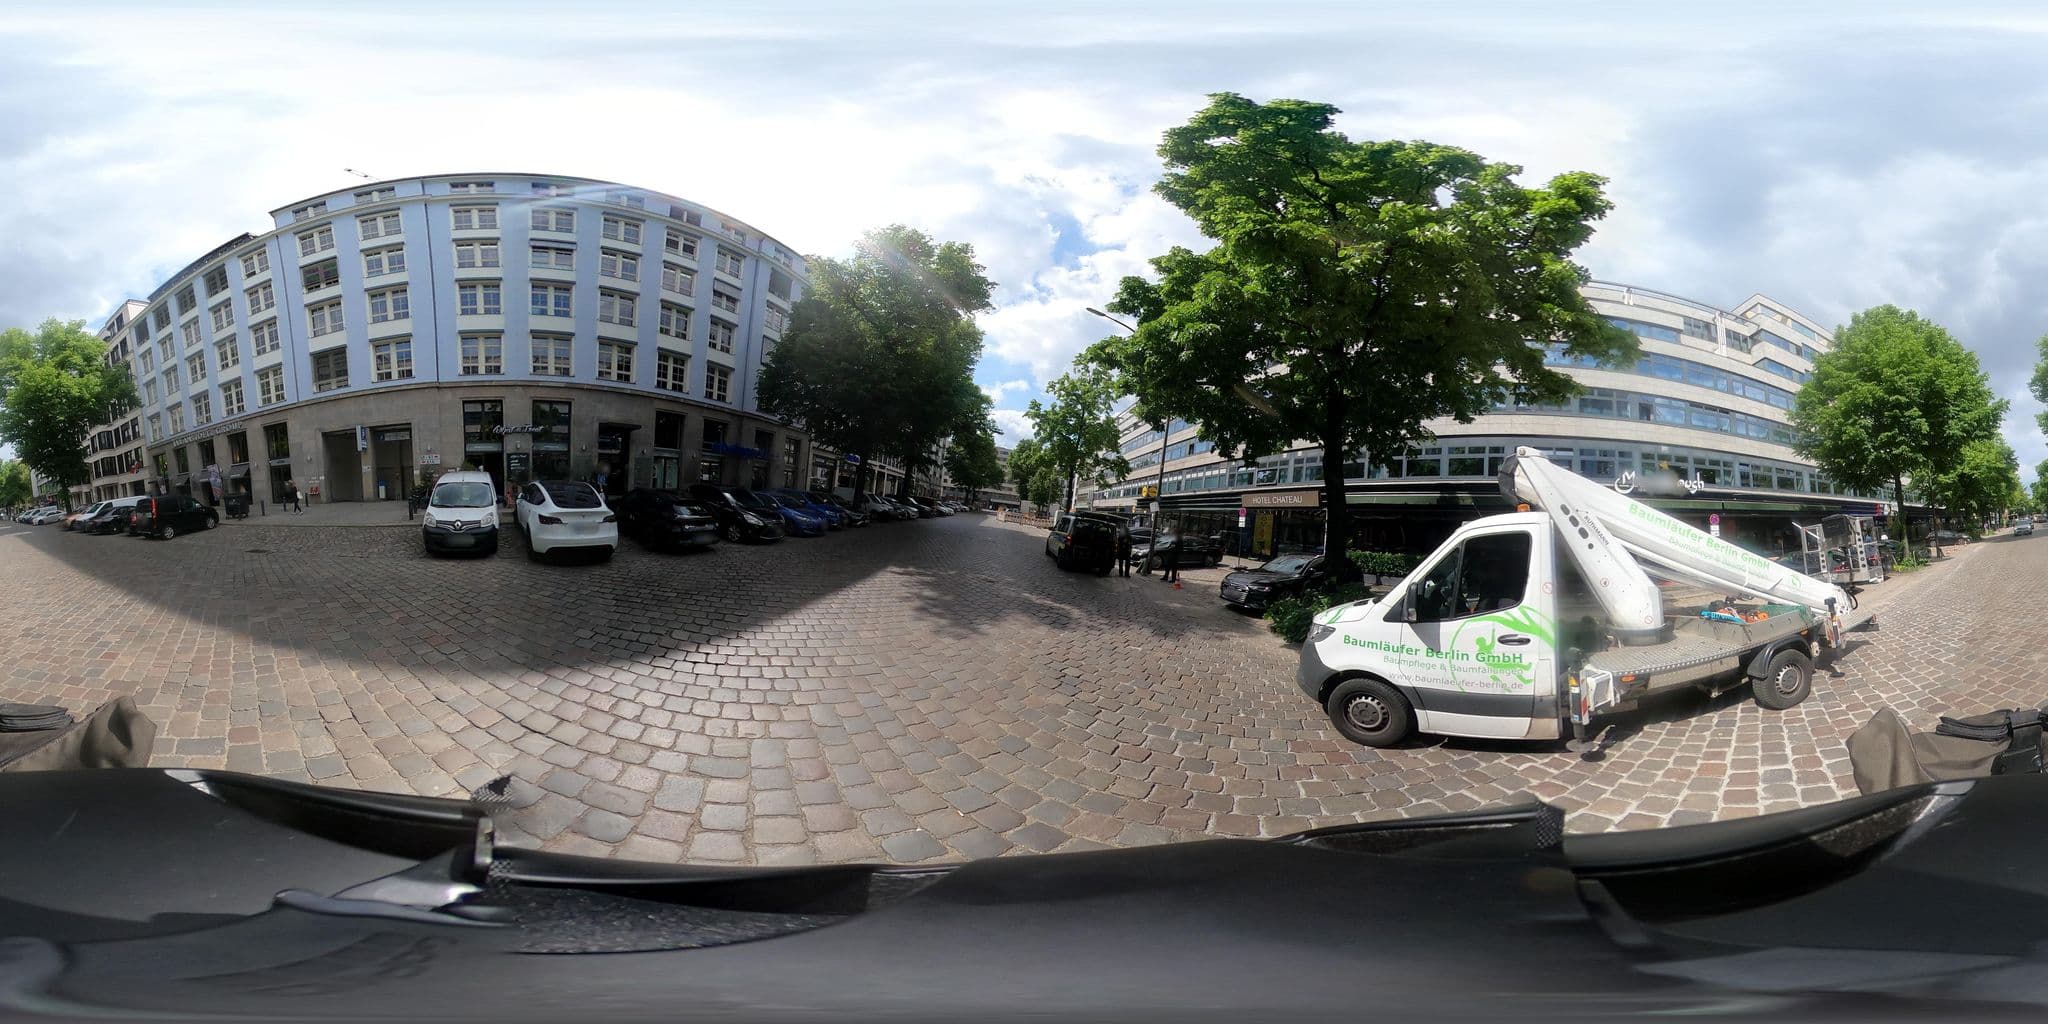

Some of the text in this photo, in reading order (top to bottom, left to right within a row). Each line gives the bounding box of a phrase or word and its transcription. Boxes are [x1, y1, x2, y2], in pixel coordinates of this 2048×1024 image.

[1252, 495, 1302, 505] HOTEL CHATEAU
[1628, 503, 1704, 542] Baumläufer
[1706, 536, 1738, 558] Berlin
[1741, 553, 1771, 570] GmbH
[1343, 634, 1523, 663] Baumläufer Berlin GmbH
[1383, 655, 1437, 670] Baumpflege
[1387, 672, 1523, 689] www.baumlaeufer-berlin.de
